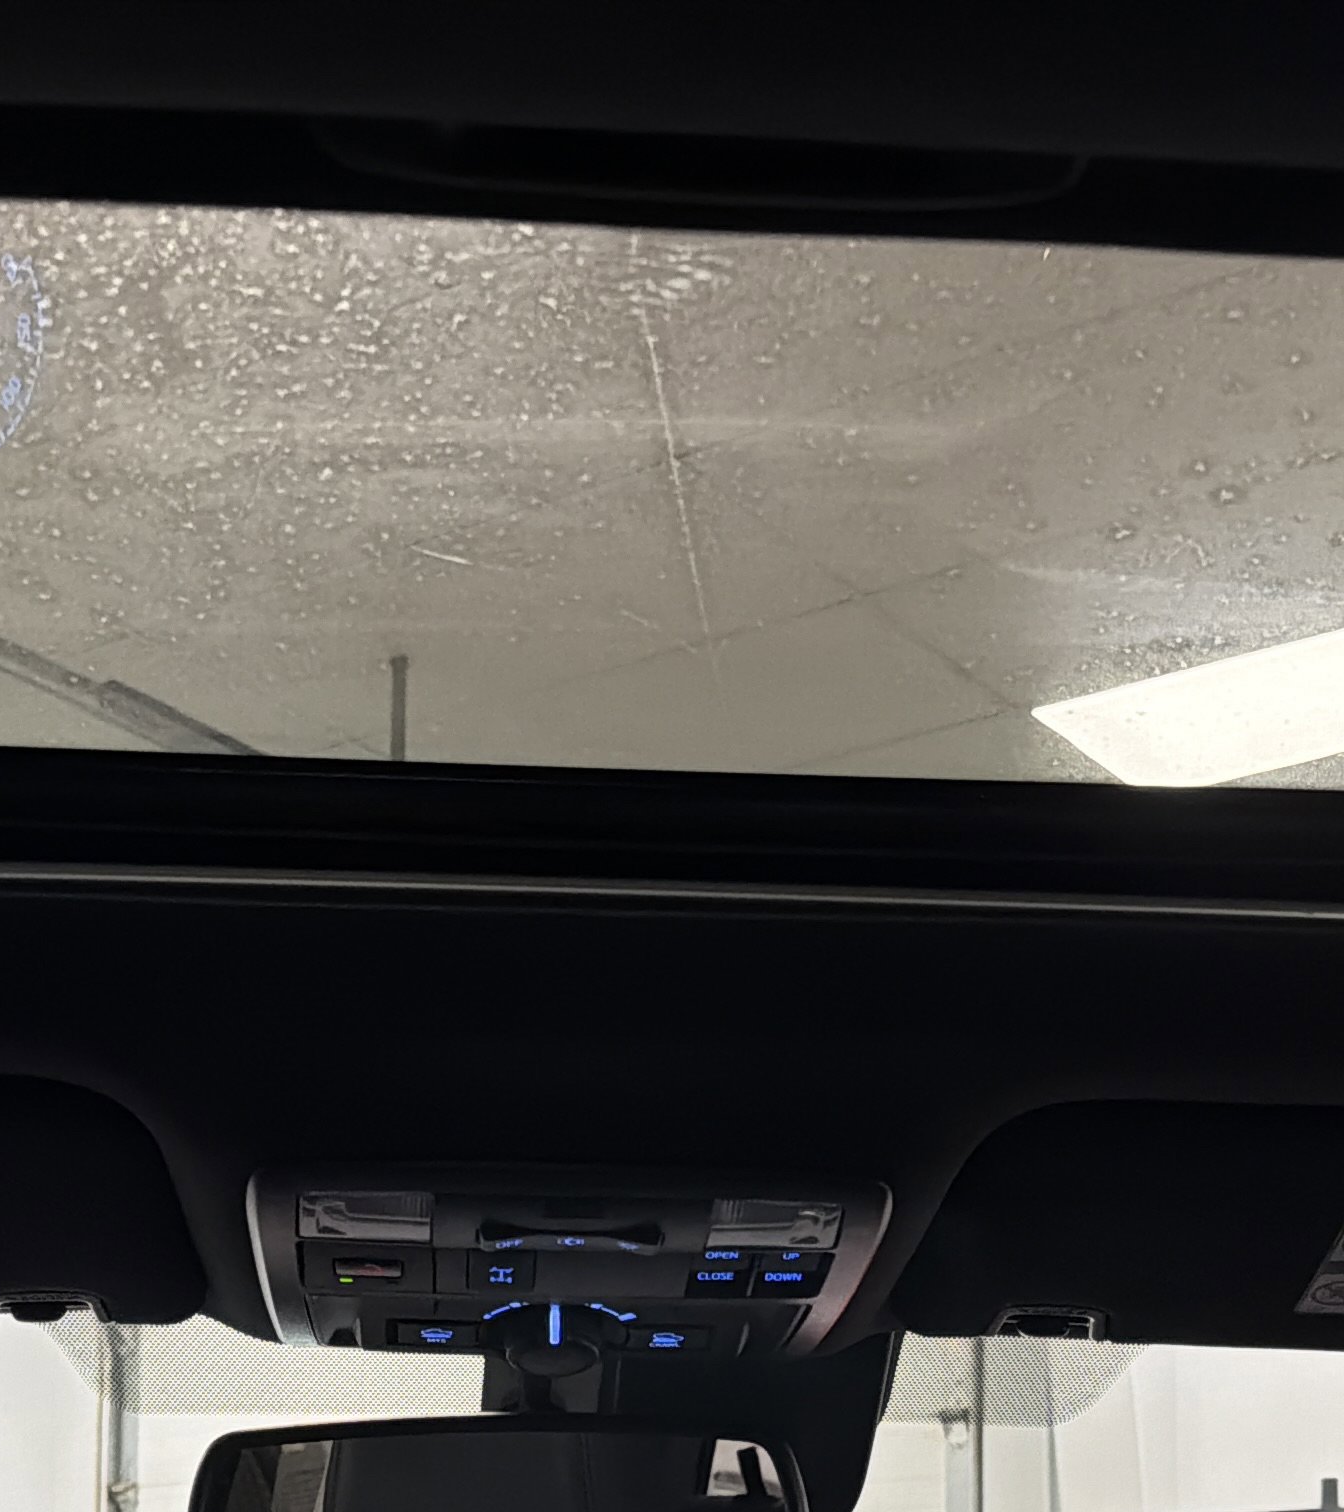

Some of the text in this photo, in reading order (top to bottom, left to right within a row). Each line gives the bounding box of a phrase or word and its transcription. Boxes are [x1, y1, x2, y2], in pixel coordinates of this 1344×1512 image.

[705, 1251, 739, 1260] OPEN
[783, 1252, 800, 1261] UP
[697, 1271, 735, 1282] CLOSE
[764, 1272, 802, 1282] DOWN
